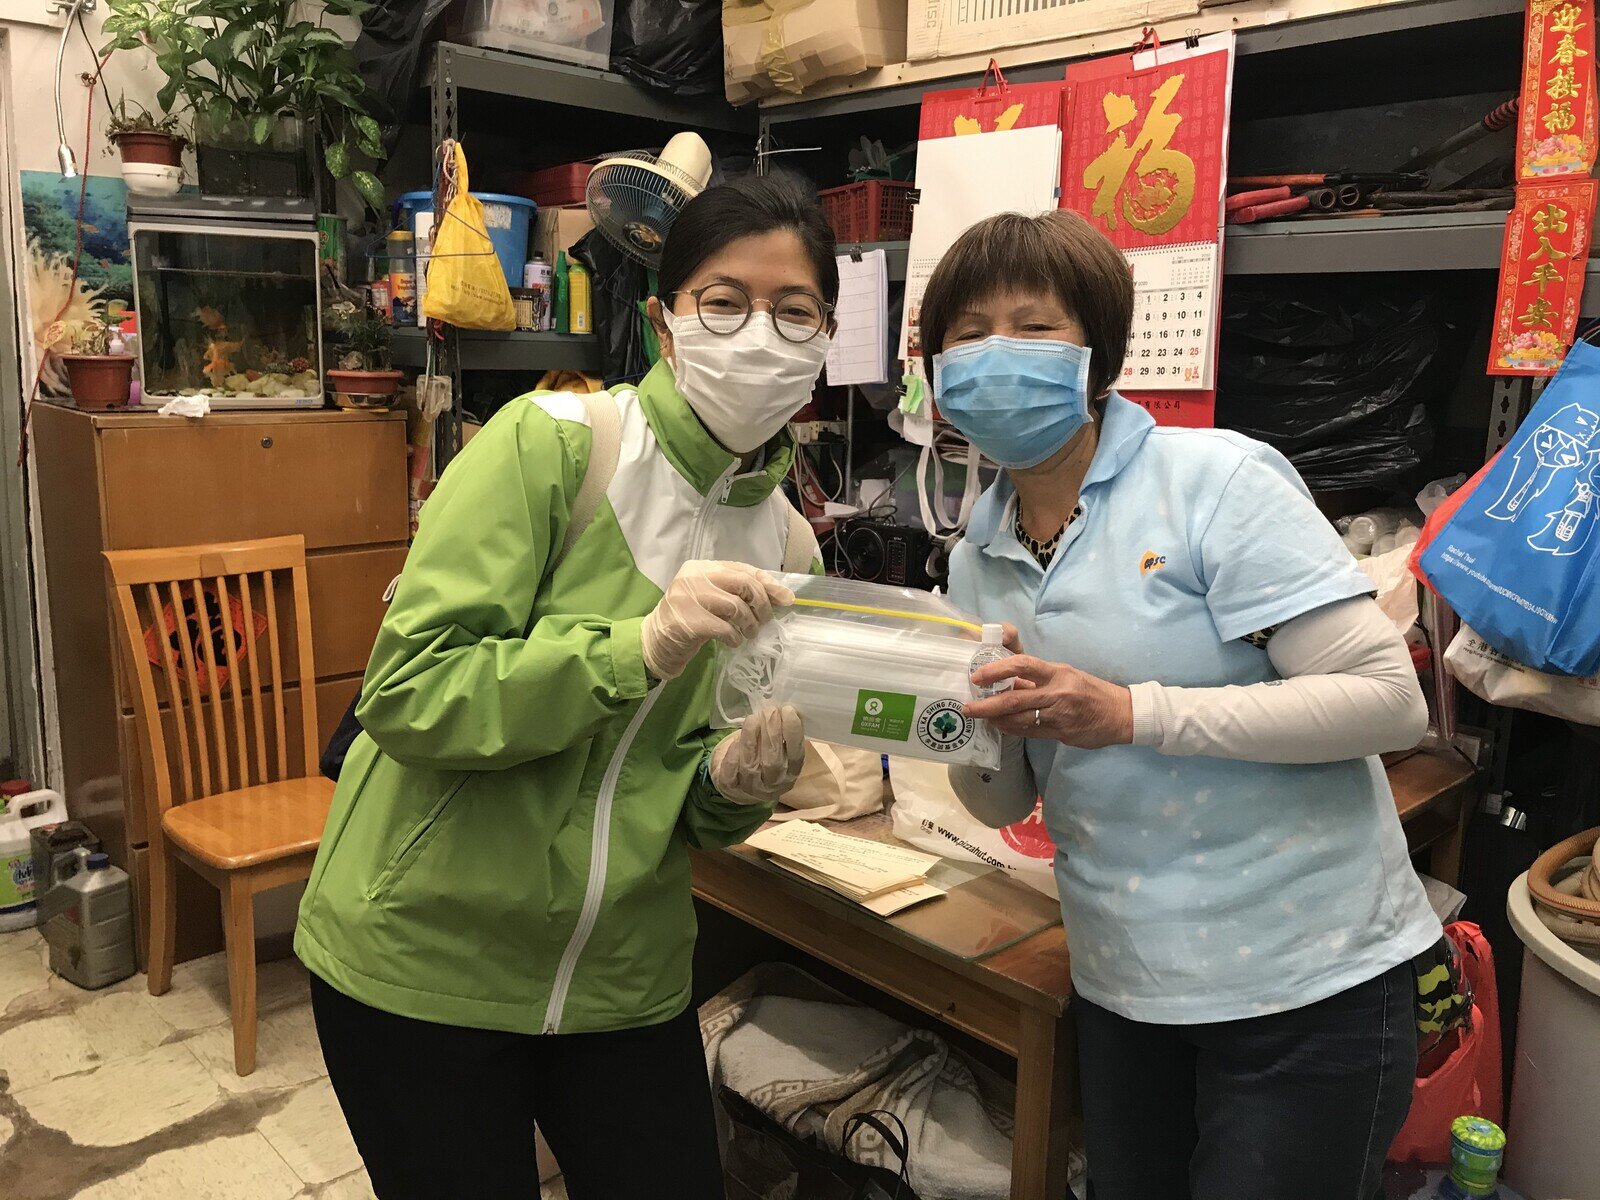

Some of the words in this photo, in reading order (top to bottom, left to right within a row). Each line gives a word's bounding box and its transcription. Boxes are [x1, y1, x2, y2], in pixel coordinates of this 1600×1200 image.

[1083, 73, 1195, 235] 福
[1517, 203, 1568, 328] 出入平安
[1147, 295, 1151, 303] 1
[1163, 294, 1168, 302] 2
[1180, 292, 1185, 300] 3
[1197, 291, 1202, 299] 4
[1145, 313, 1151, 321] 8
[1162, 312, 1167, 320] 9
[1177, 310, 1187, 319] 10
[1194, 310, 1202, 318] 11
[1143, 331, 1152, 339] 15
[1159, 330, 1169, 338] 16
[1176, 329, 1185, 337] 17
[1192, 328, 1201, 337] 18
[1141, 349, 1151, 357] 22
[1157, 348, 1167, 356] 23
[1173, 348, 1183, 356] 24
[1190, 347, 1199, 356] 25
[1123, 367, 1133, 375] 28
[1140, 367, 1149, 375] 29
[1156, 366, 1166, 375] 30
[1172, 366, 1180, 375] 31
[1447, 544, 1464, 558] Rachel
[1463, 553, 1476, 564] Tsui
[926, 701, 946, 715] SHING
[937, 826, 1017, 871] www.pizzahut.com
